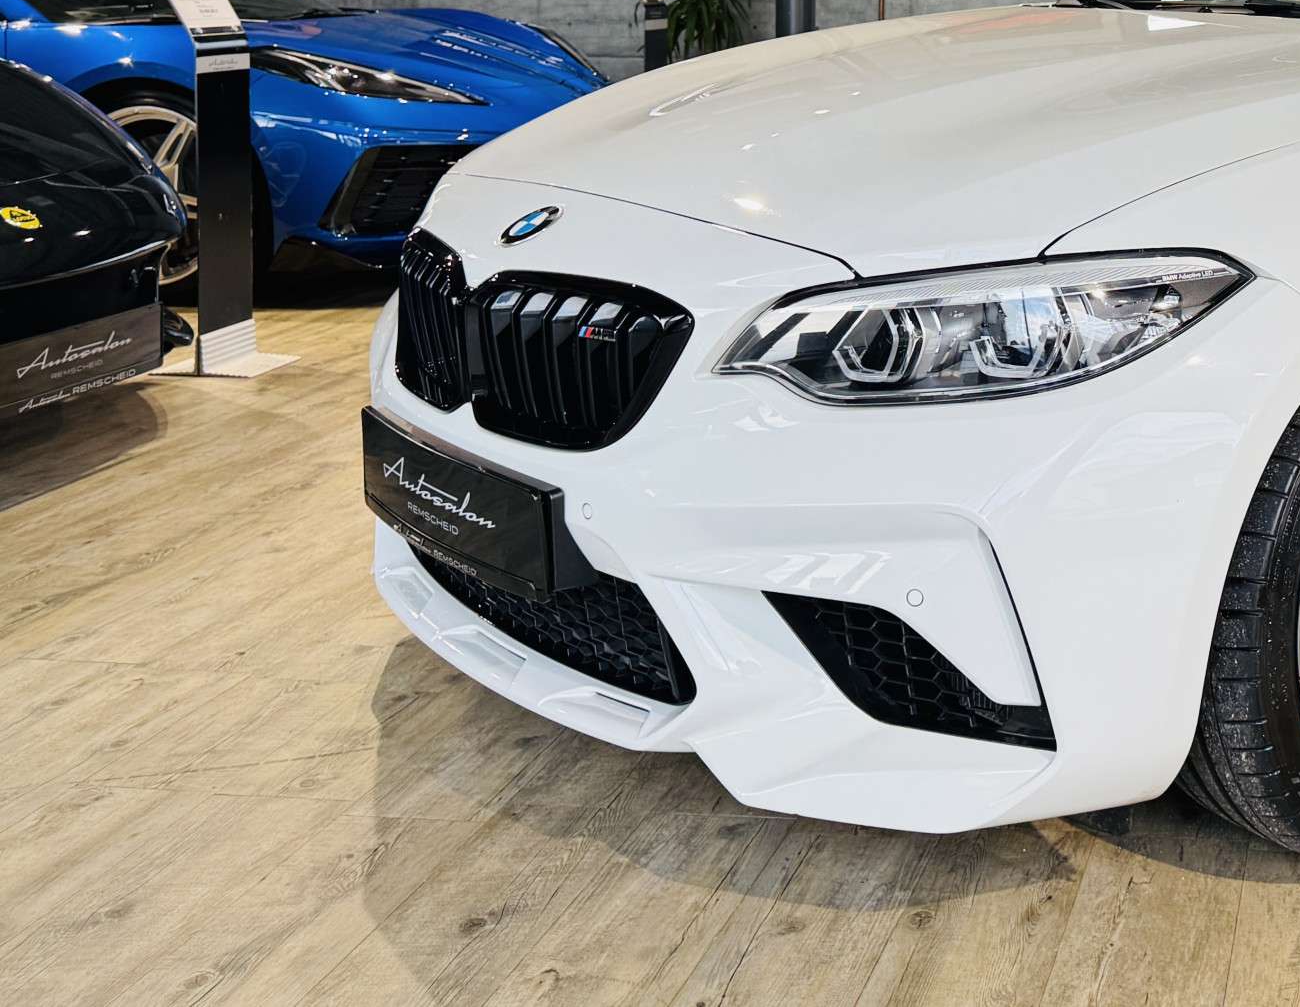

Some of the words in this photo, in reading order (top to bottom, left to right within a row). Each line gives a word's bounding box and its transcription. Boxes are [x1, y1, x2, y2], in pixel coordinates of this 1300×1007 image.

[72, 368, 136, 394] REMSCHEID
[383, 456, 496, 529] Autosalon
[407, 501, 459, 535] REMSCHEID
